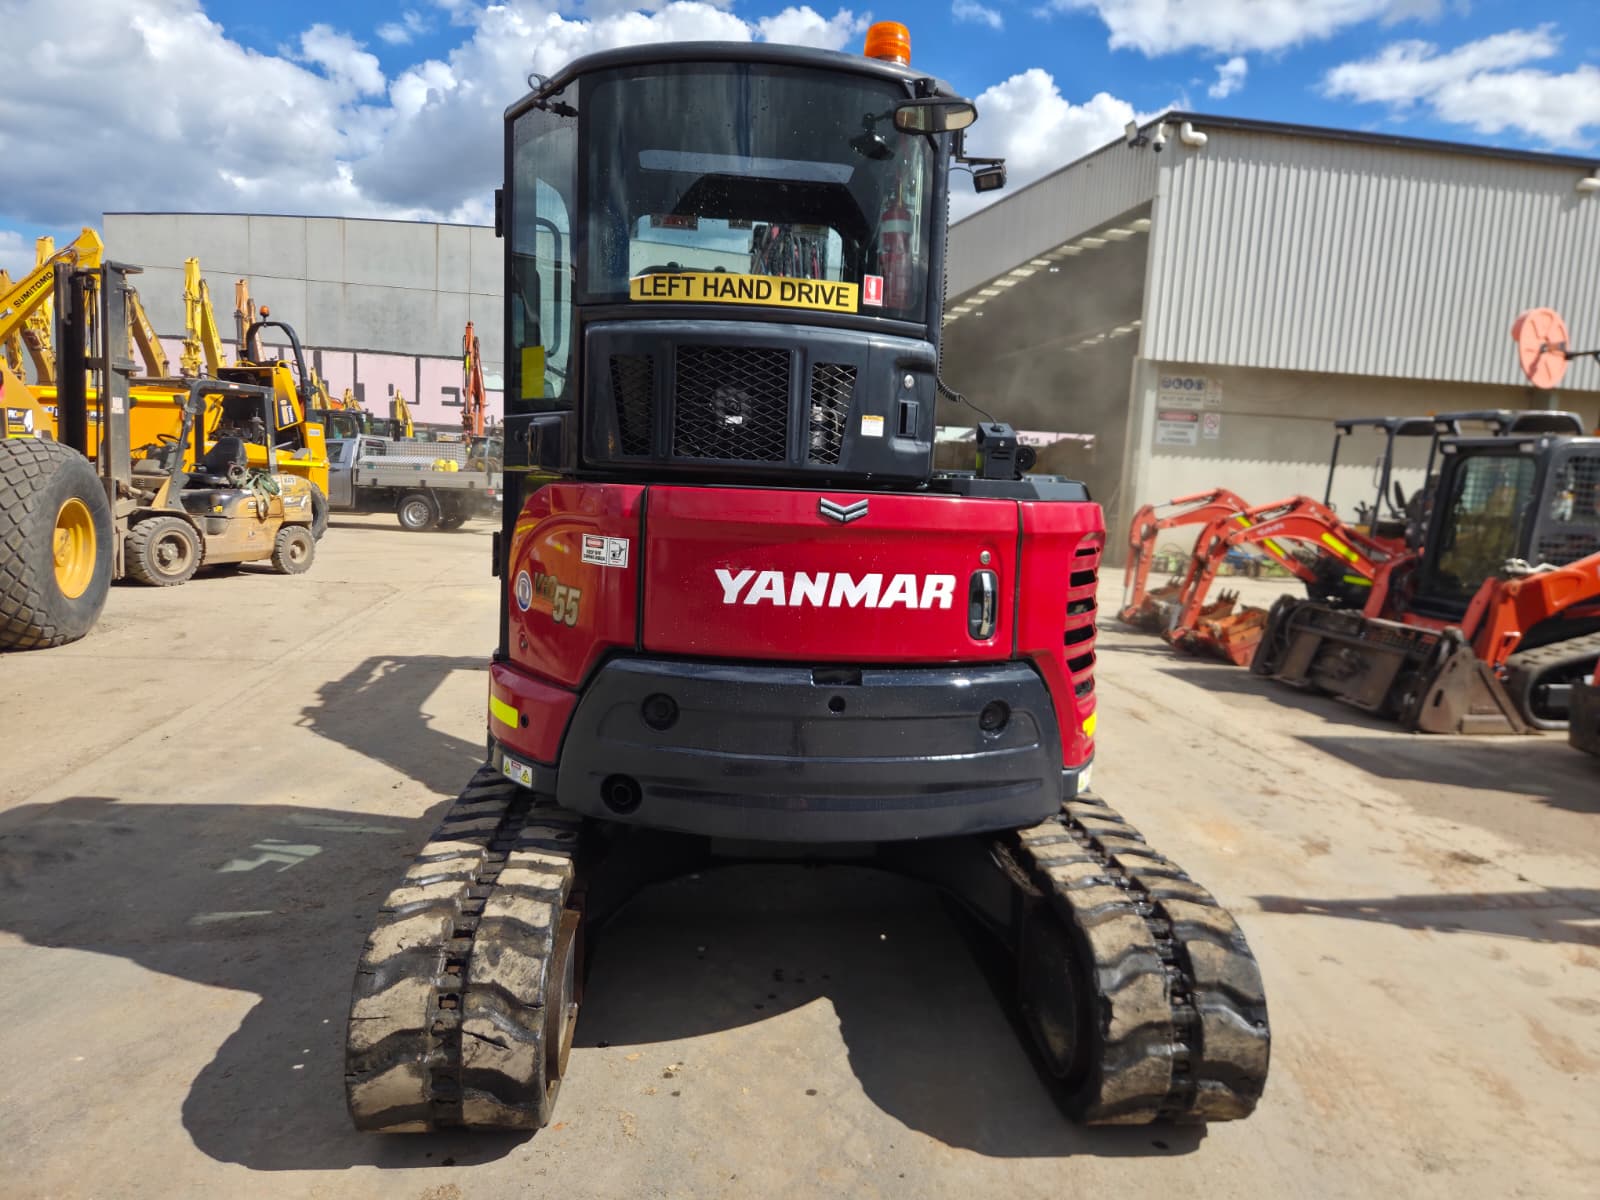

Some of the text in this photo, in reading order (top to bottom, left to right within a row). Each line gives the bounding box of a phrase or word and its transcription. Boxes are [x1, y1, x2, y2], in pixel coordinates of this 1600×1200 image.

[13, 271, 53, 308] SUMITOMO
[640, 275, 850, 307] LEFT HAND DRIVE
[714, 569, 957, 609] YANMAR
